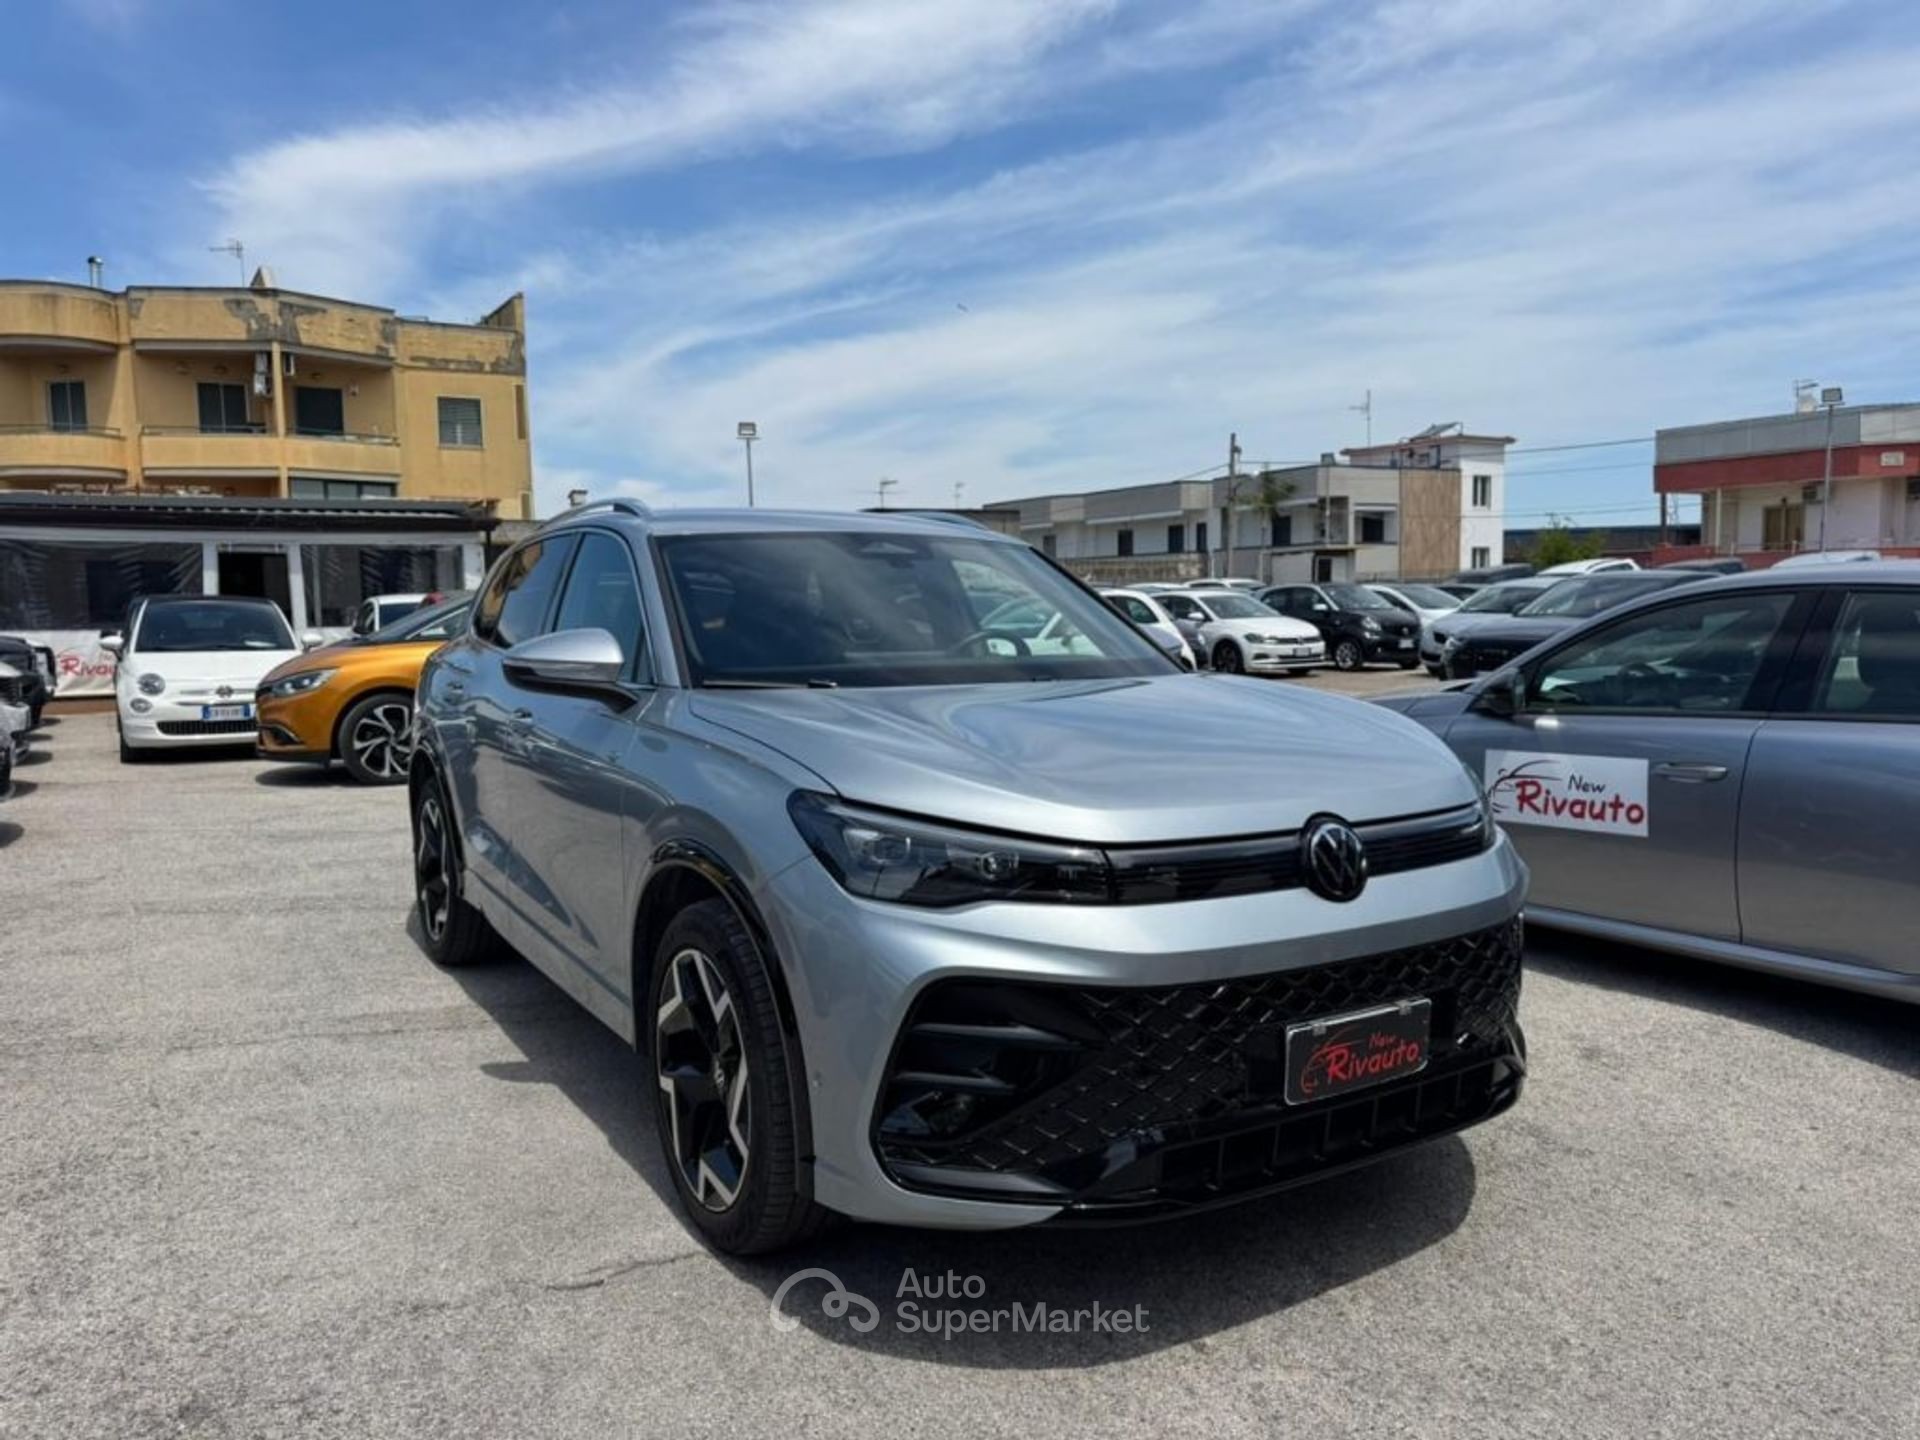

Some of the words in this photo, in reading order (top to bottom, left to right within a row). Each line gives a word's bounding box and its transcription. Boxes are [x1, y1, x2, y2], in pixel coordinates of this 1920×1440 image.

[1568, 774, 1606, 794] New
[1515, 780, 1645, 824] Rivauto
[1369, 1031, 1396, 1049] New
[1326, 1039, 1419, 1084] Rivauto
